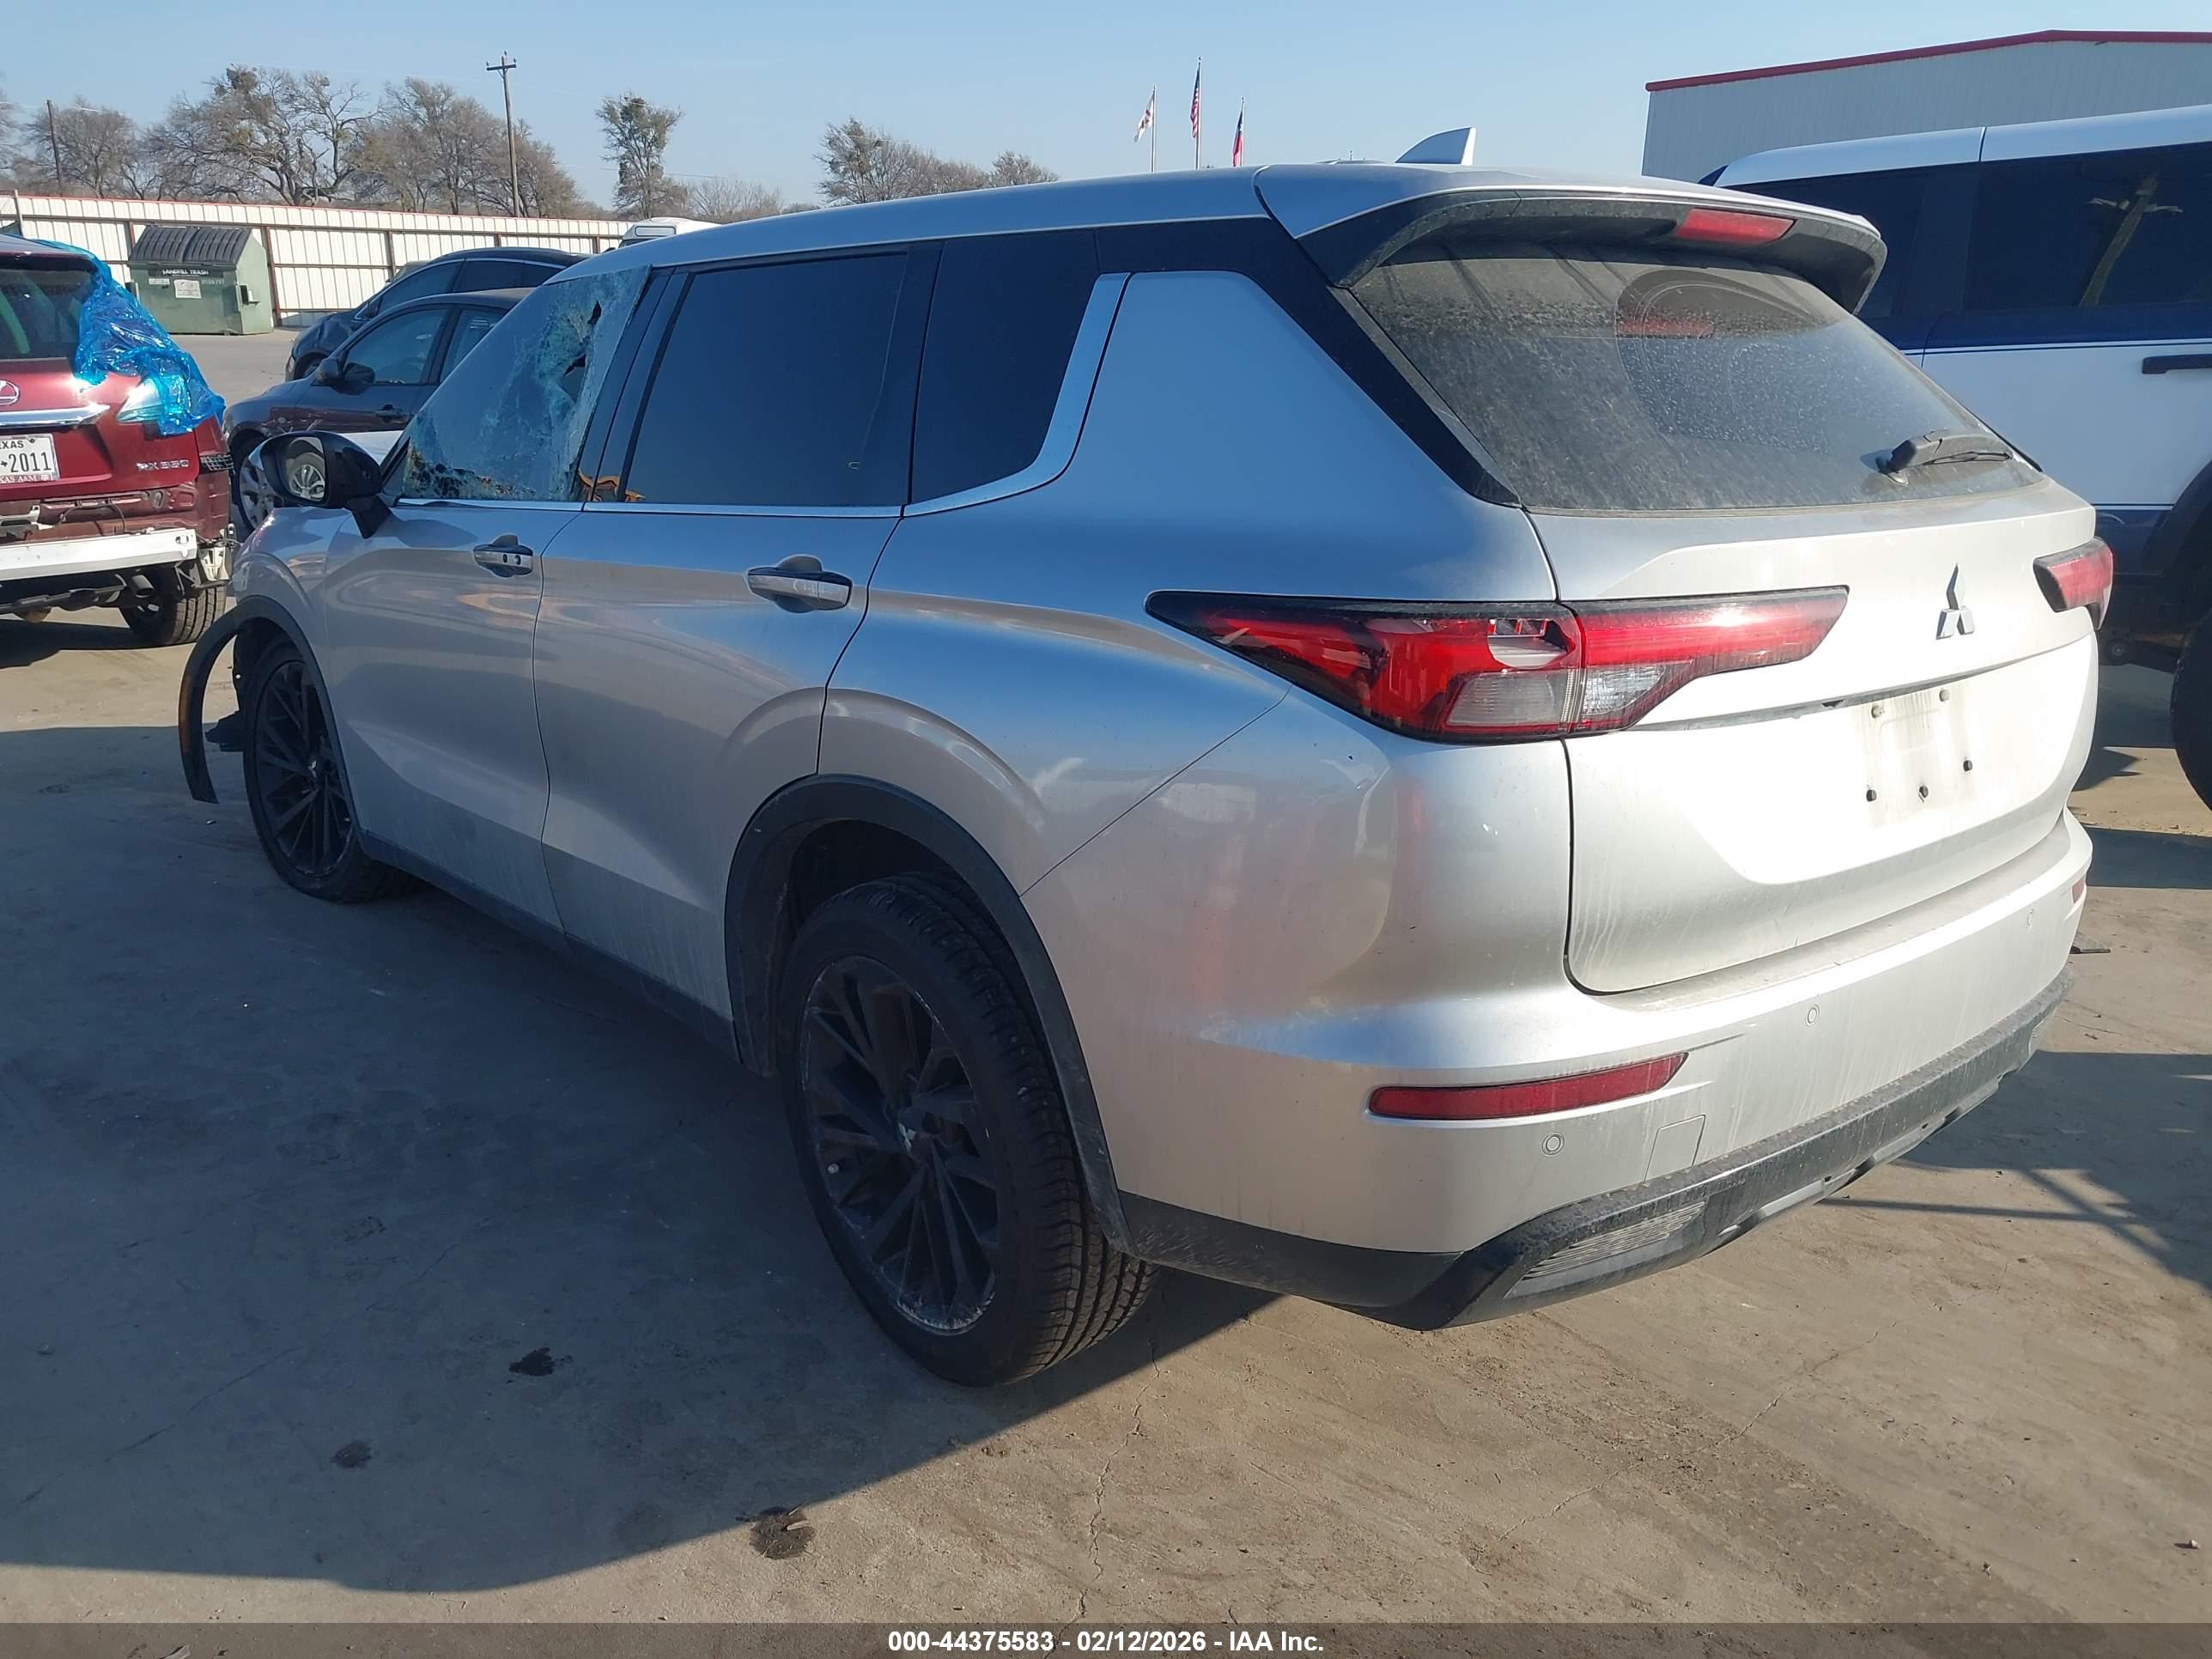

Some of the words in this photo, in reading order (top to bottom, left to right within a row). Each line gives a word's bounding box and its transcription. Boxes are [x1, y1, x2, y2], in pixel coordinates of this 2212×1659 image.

[0, 440, 24, 449] XAS
[9, 452, 52, 472] 2011
[160, 459, 189, 469] 350
